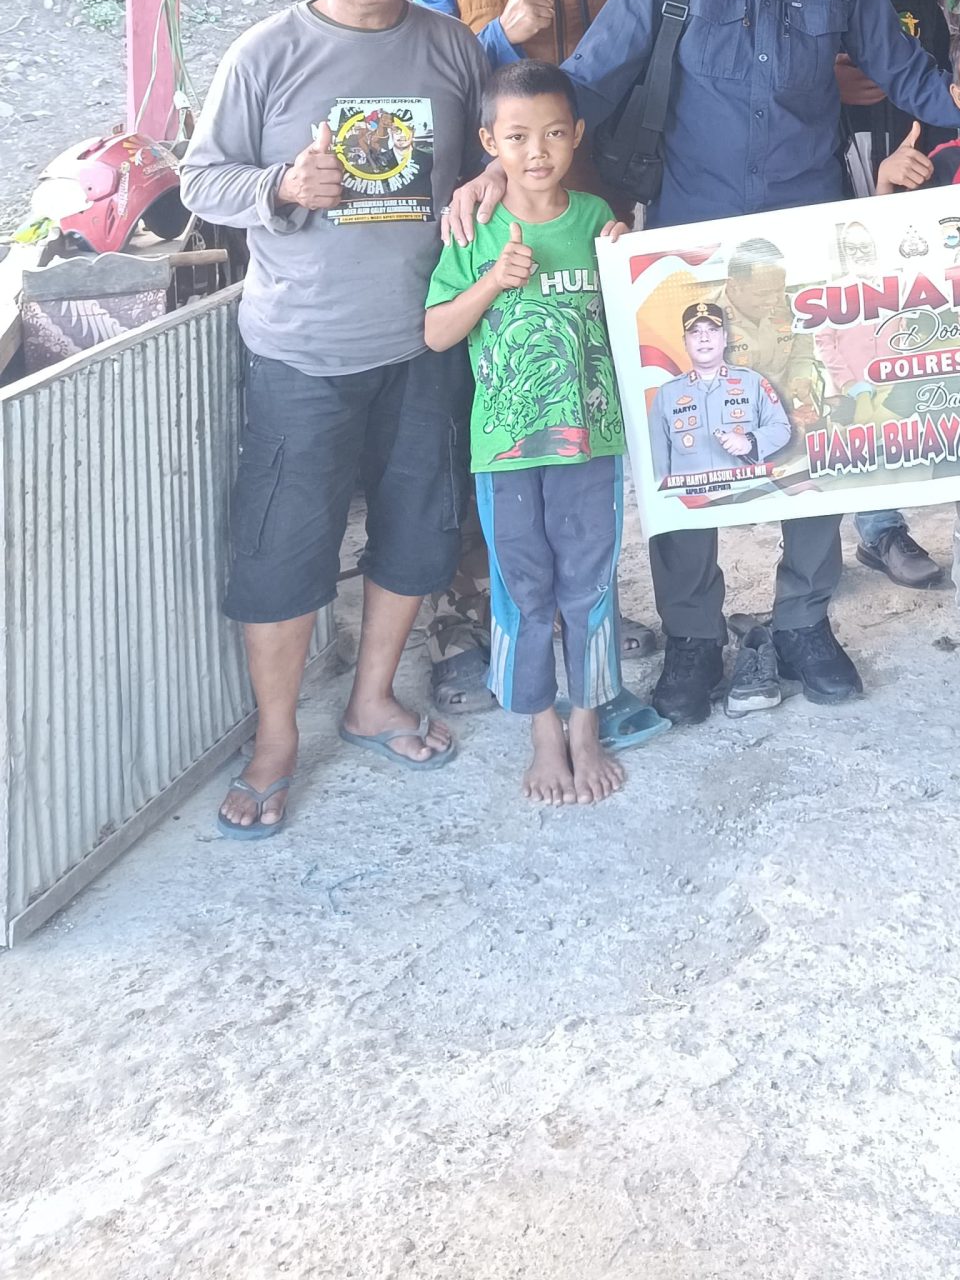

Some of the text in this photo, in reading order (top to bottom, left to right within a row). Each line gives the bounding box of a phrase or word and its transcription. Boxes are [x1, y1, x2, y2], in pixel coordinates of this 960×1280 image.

[724, 398, 750, 406] POLRI
[672, 405, 697, 415] HARYO
[807, 425, 876, 474] HARI
[686, 473, 708, 486] HARYO
